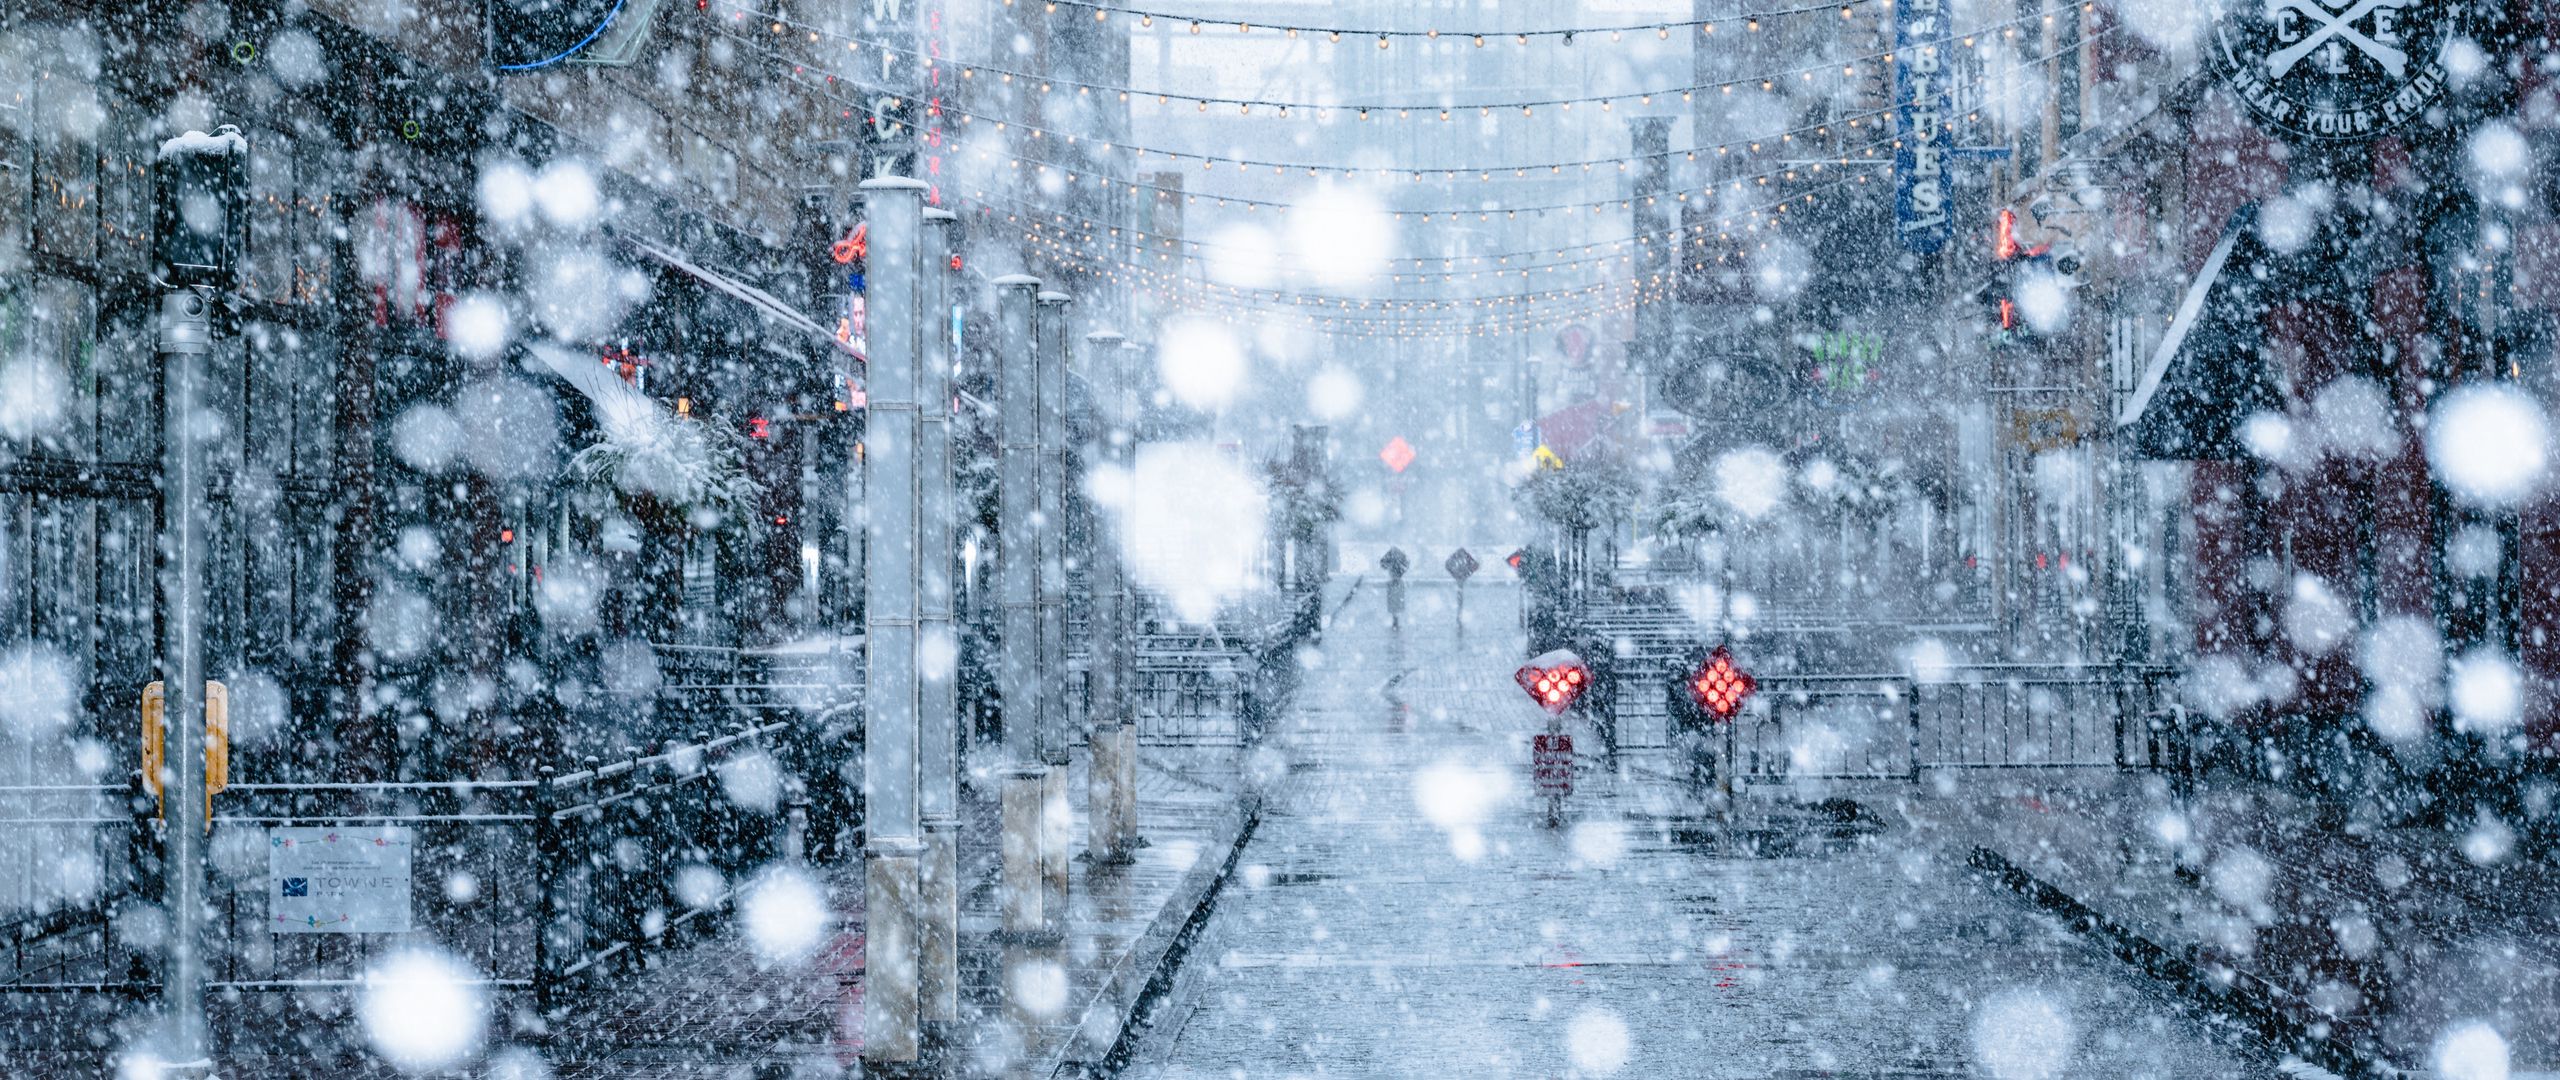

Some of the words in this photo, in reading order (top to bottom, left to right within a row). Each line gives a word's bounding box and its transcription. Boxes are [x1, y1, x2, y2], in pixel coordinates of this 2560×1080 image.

[1911, 45, 1940, 213] BLUES
[2232, 68, 2290, 121] WEAR
[2306, 110, 2369, 133] YOUR
[2381, 62, 2447, 122] PRIDE
[315, 877, 393, 889] TOWNE
